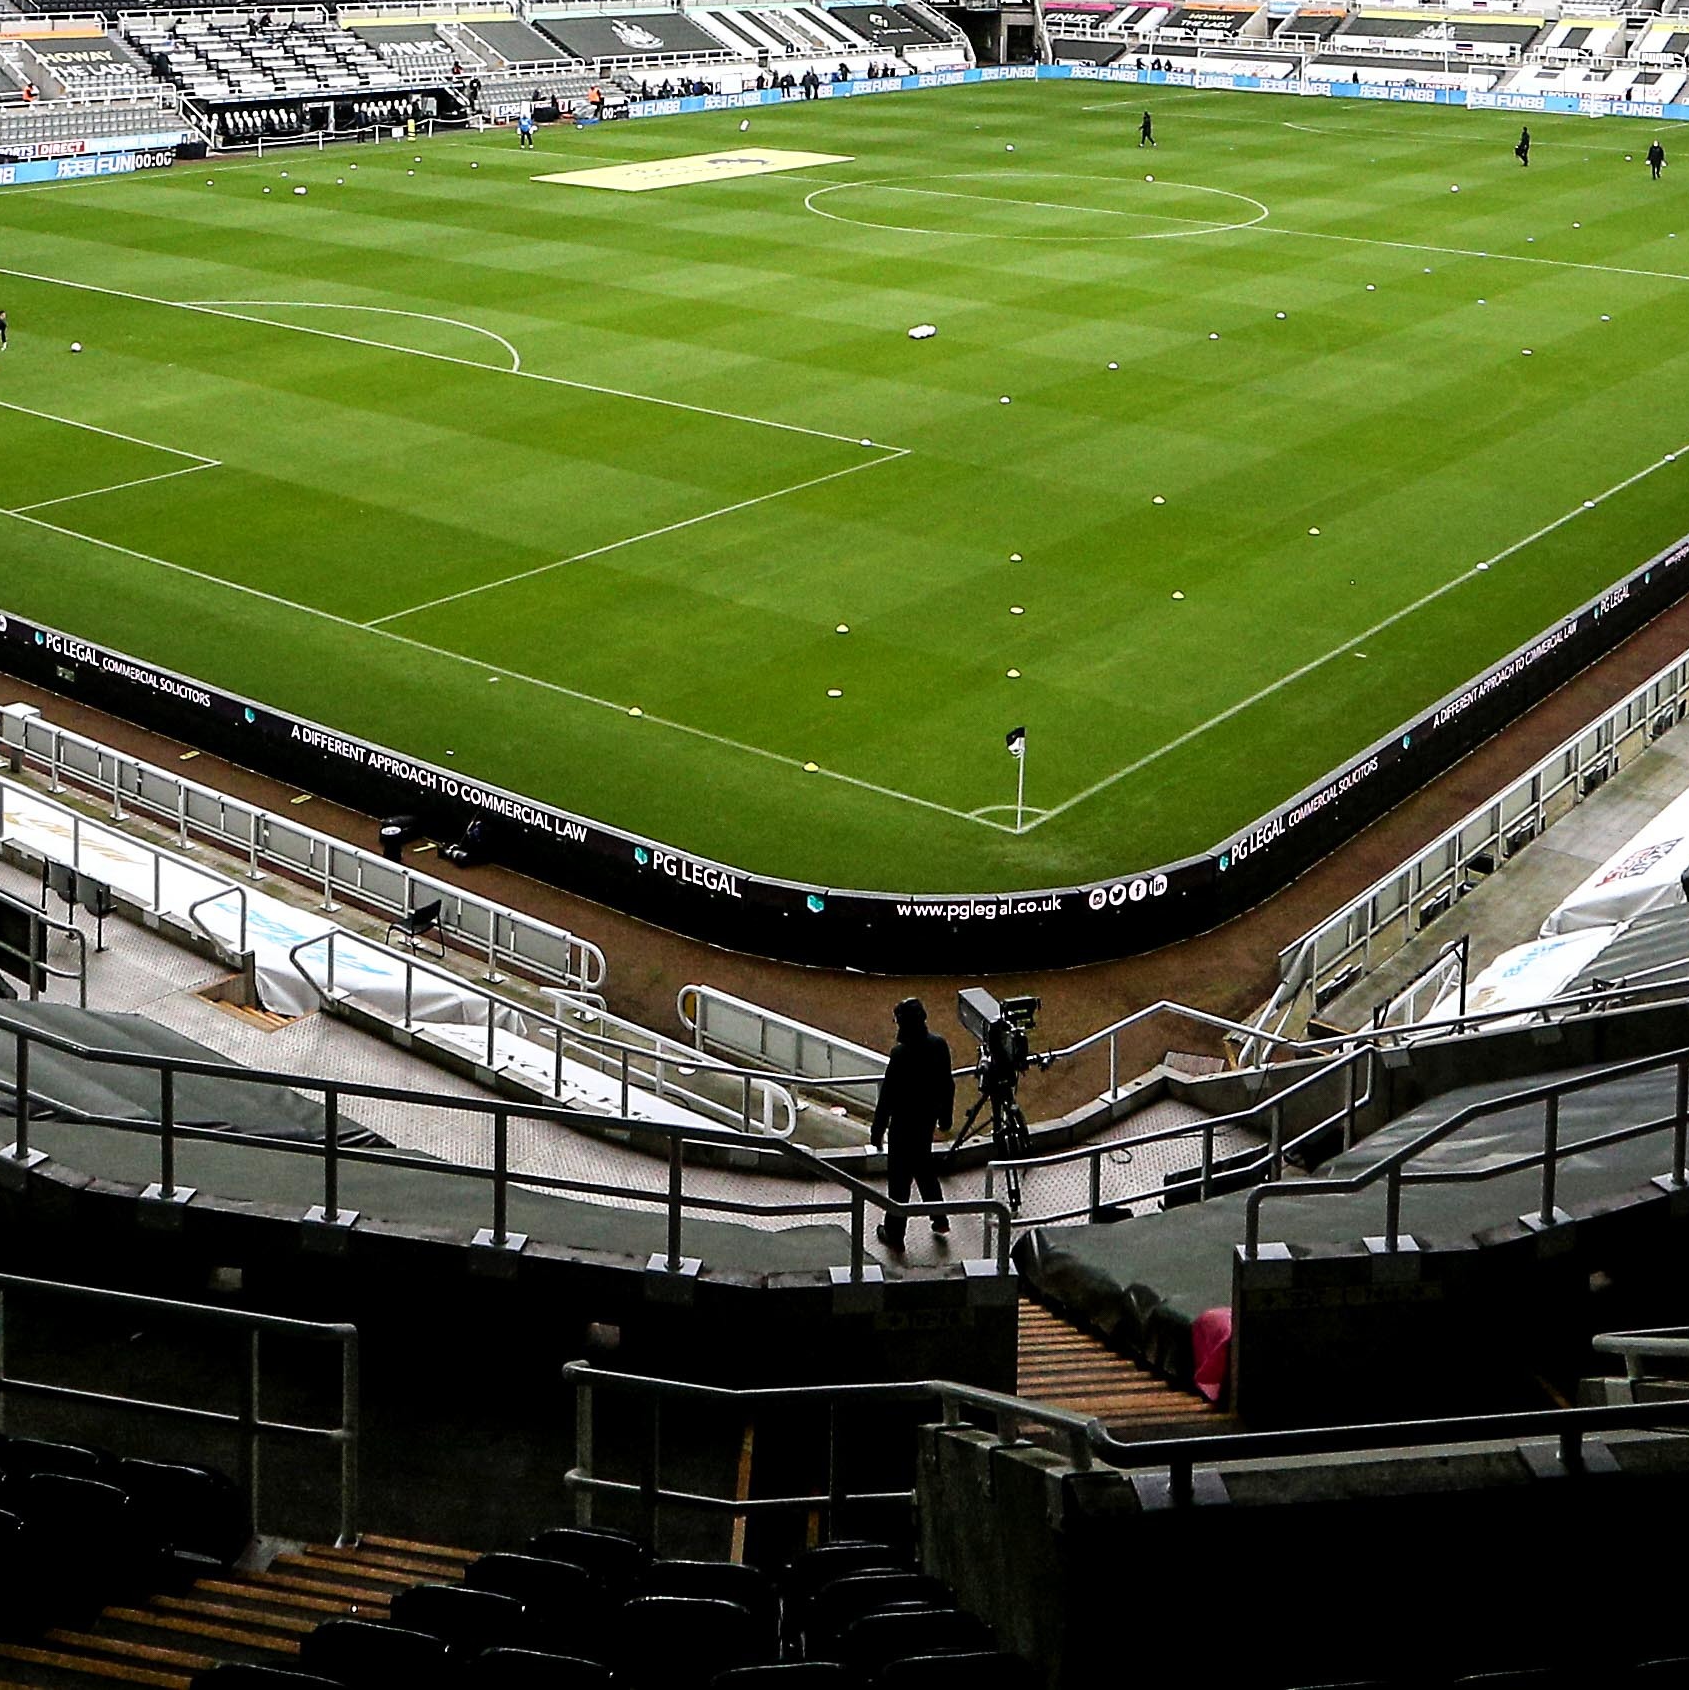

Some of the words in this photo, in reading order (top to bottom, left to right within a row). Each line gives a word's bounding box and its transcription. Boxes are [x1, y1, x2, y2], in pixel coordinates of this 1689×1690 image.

[36, 50, 113, 63] HOWAY
[379, 40, 452, 57] #NUFC
[50, 64, 88, 77] THE
[86, 62, 137, 76] LADS
[1389, 87, 1436, 103] FUN88
[1612, 101, 1664, 118] FUN88
[40, 141, 85, 155] DIRECT
[1600, 596, 1610, 616] PG
[1610, 584, 1630, 609] LEGAL
[46, 632, 61, 654] PG
[62, 638, 100, 667] LEGAL
[102, 656, 159, 688] COMMERCIAL
[159, 677, 212, 708] SOLICITORS
[1433, 714, 1440, 729] A
[1440, 686, 1479, 724] DIFFERENT
[1478, 663, 1515, 699] APPROACH
[1515, 656, 1525, 673] TO
[1525, 630, 1563, 665] COMMERCIAL
[1563, 619, 1578, 640] LAW
[291, 724, 301, 740] A
[302, 727, 367, 764] DIFFERENT
[368, 752, 437, 790] APPROACH
[439, 776, 459, 797] TO
[460, 785, 553, 832] COMMERCIAL
[555, 818, 587, 843] LAW
[1230, 838, 1248, 866] PG
[1249, 816, 1286, 855] LEGAL
[1288, 785, 1339, 828] COMMERCIAL
[1338, 756, 1379, 795] SOLICITORS
[653, 850, 678, 877] PG
[681, 859, 742, 899] LEGAL
[896, 896, 1063, 921] www.pglegal.co.uk
